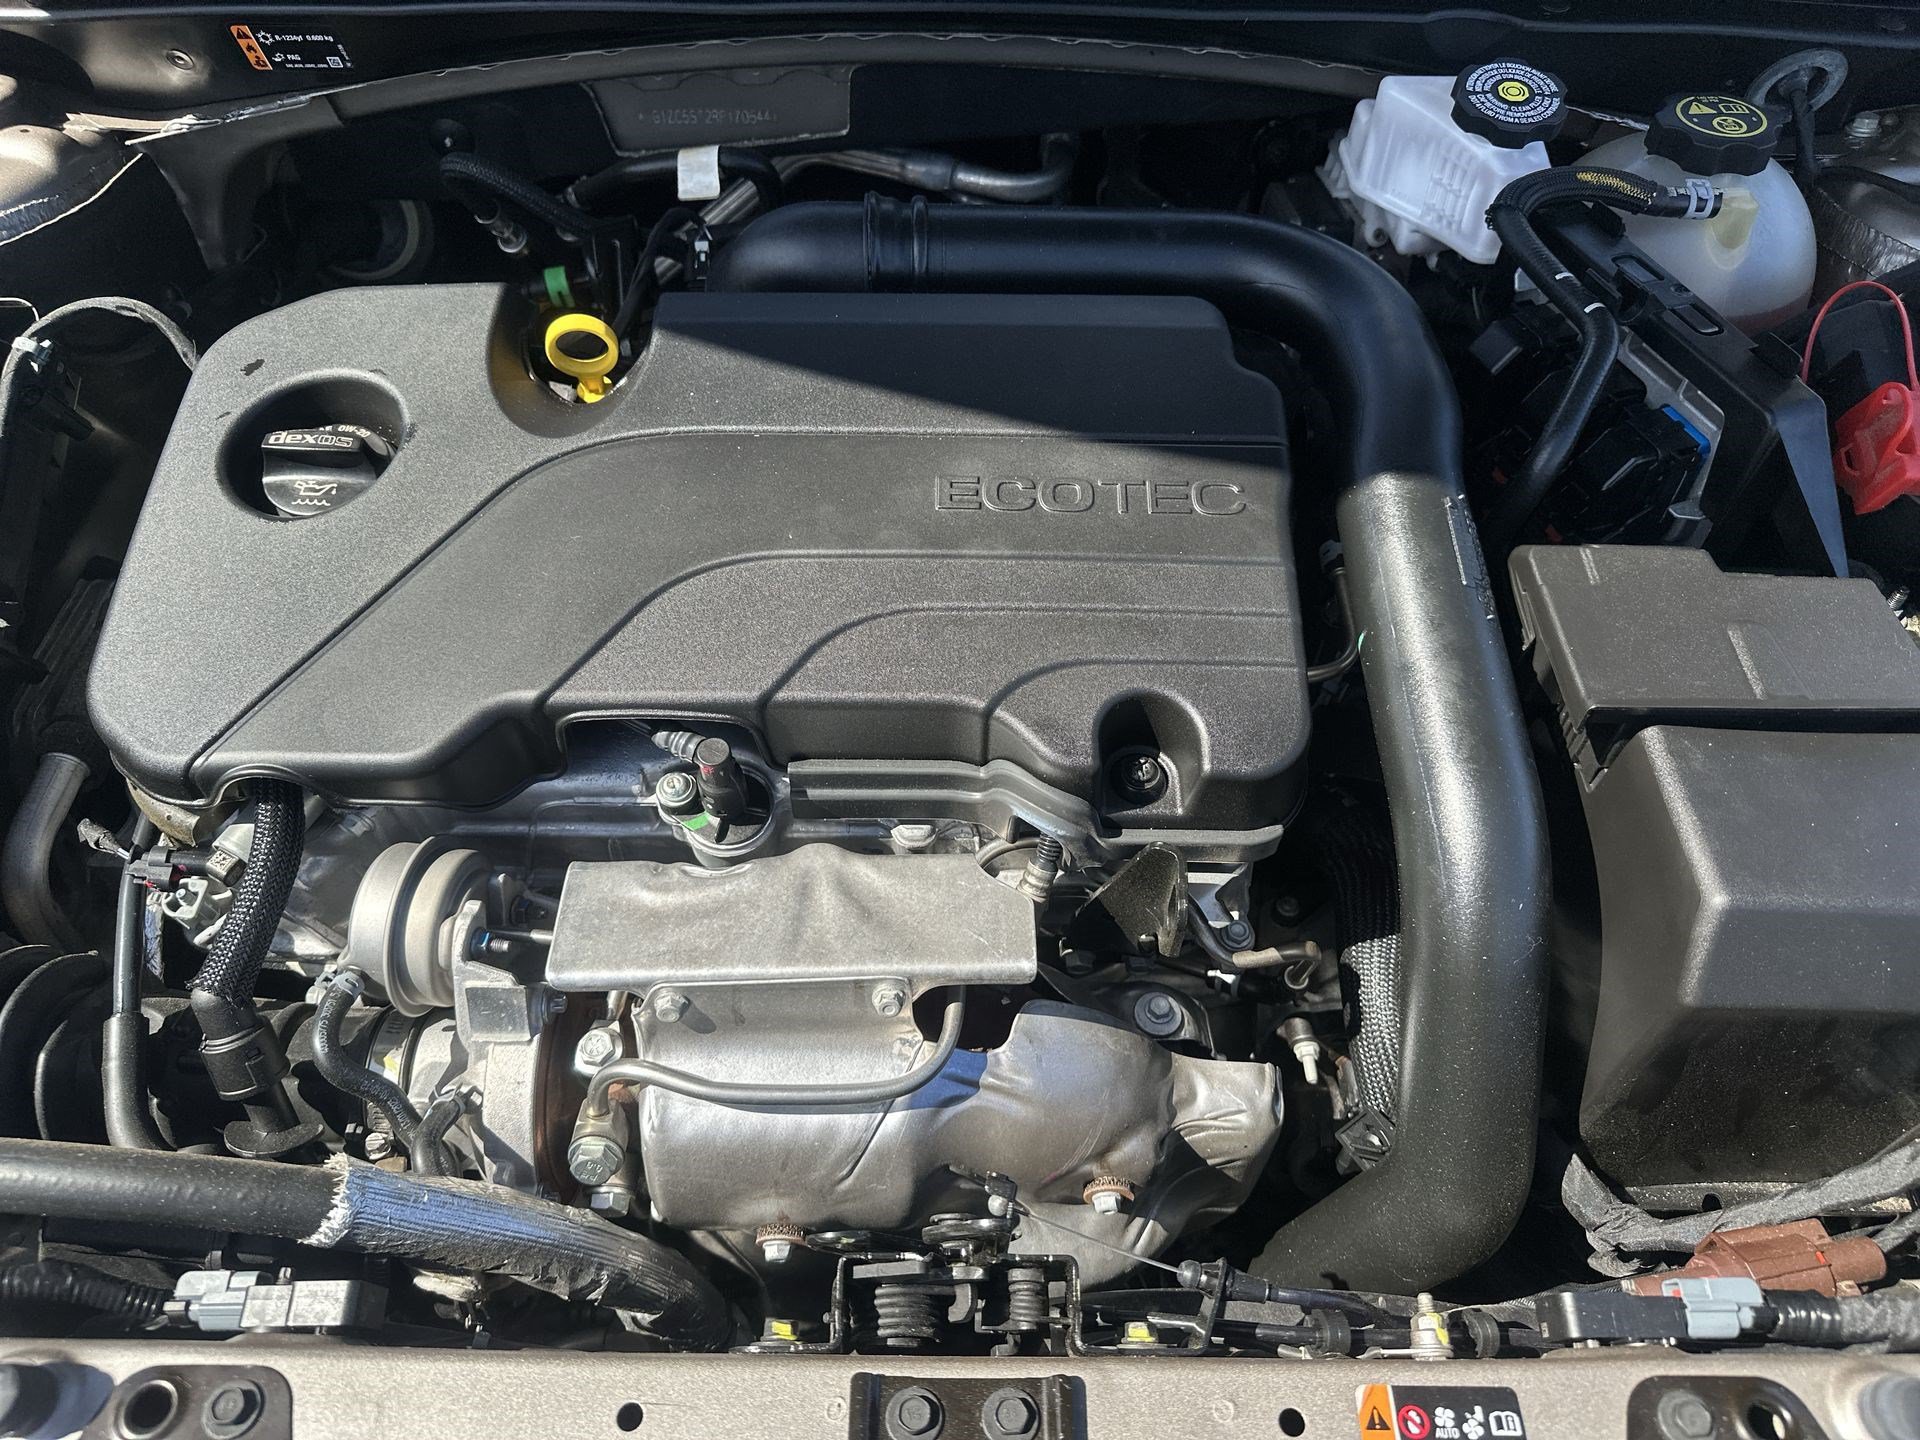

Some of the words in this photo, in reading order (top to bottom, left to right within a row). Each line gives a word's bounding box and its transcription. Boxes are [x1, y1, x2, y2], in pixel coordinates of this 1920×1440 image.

[1477, 94, 1488, 103] CAP
[1484, 102, 1506, 115] BEFORE
[1477, 105, 1496, 117] FLUID
[1494, 114, 1513, 124] FROM
[1520, 116, 1545, 125] SEALED
[268, 430, 354, 448] dexos
[338, 424, 371, 438] 0W-20
[934, 475, 1247, 516] ECOTEC
[1435, 1427, 1460, 1439] AUTO
